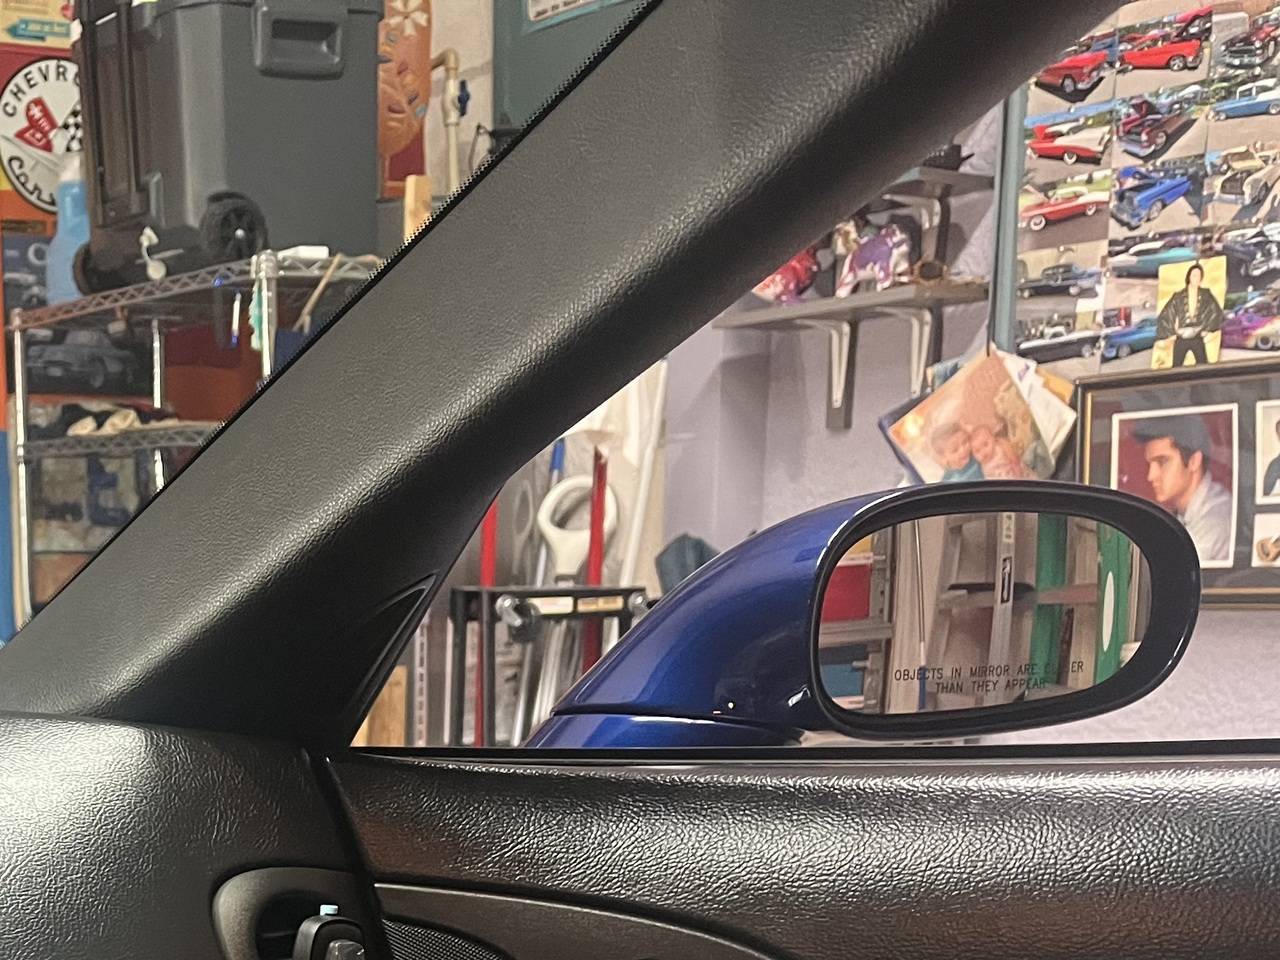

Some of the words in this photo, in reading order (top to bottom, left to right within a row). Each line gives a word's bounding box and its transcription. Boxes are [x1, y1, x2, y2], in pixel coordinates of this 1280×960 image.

[894, 667, 944, 681] OBJECTS
[951, 666, 962, 679] IN
[970, 664, 1010, 678] MIRROR
[1017, 662, 1038, 675] ARE
[936, 682, 963, 694] THAN
[972, 681, 997, 694] THEY
[1005, 678, 1046, 691] APPEAR
